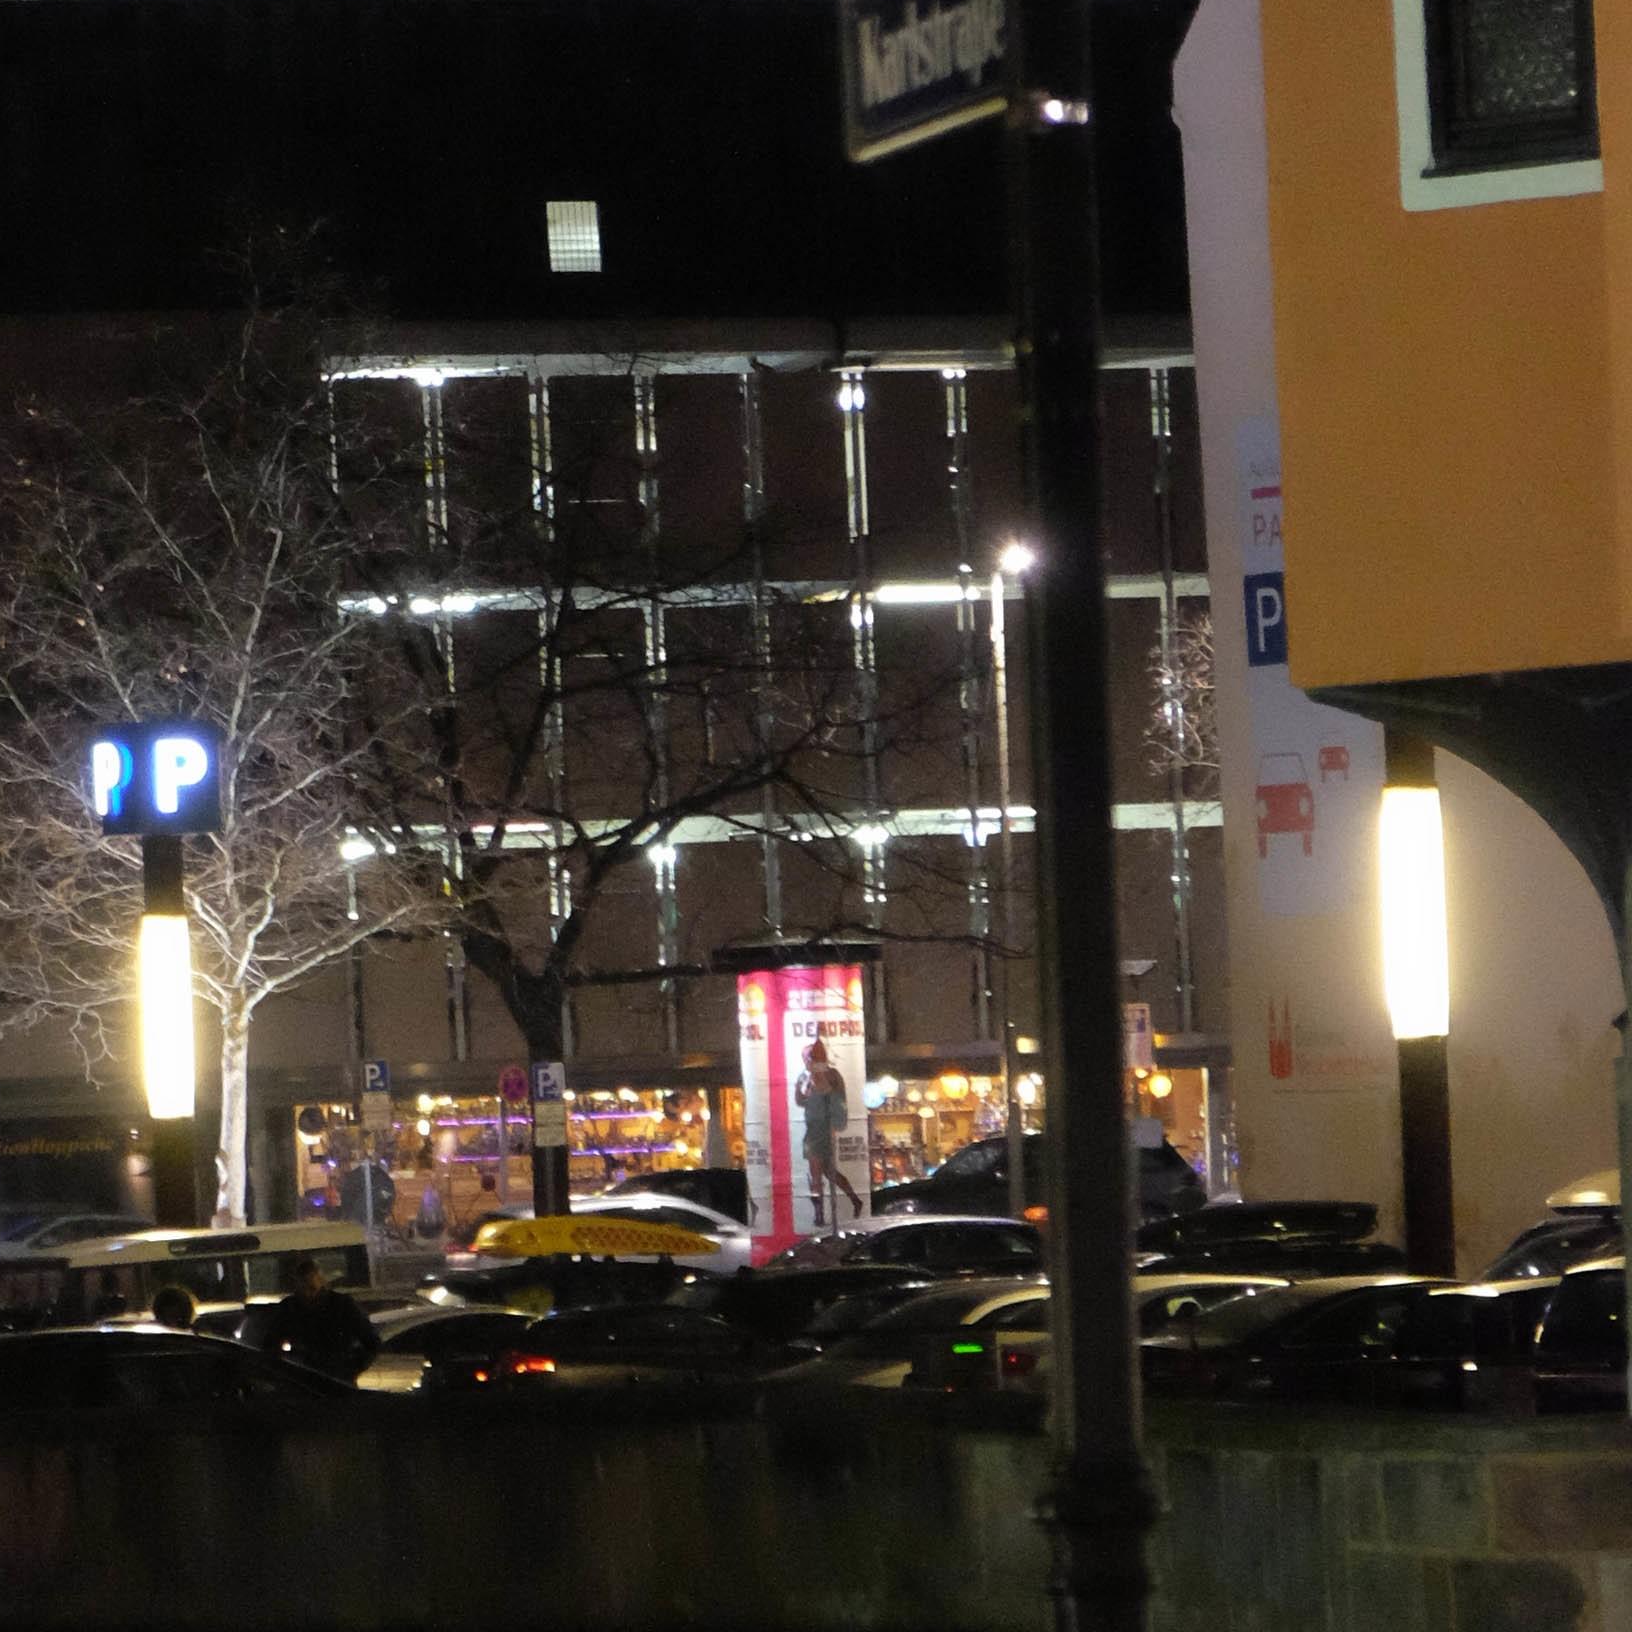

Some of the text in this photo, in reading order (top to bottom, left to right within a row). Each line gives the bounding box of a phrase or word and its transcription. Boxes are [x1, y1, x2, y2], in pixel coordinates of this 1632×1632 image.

[1256, 586, 1283, 654] P
[154, 737, 208, 814] P
[365, 1063, 381, 1089] P
